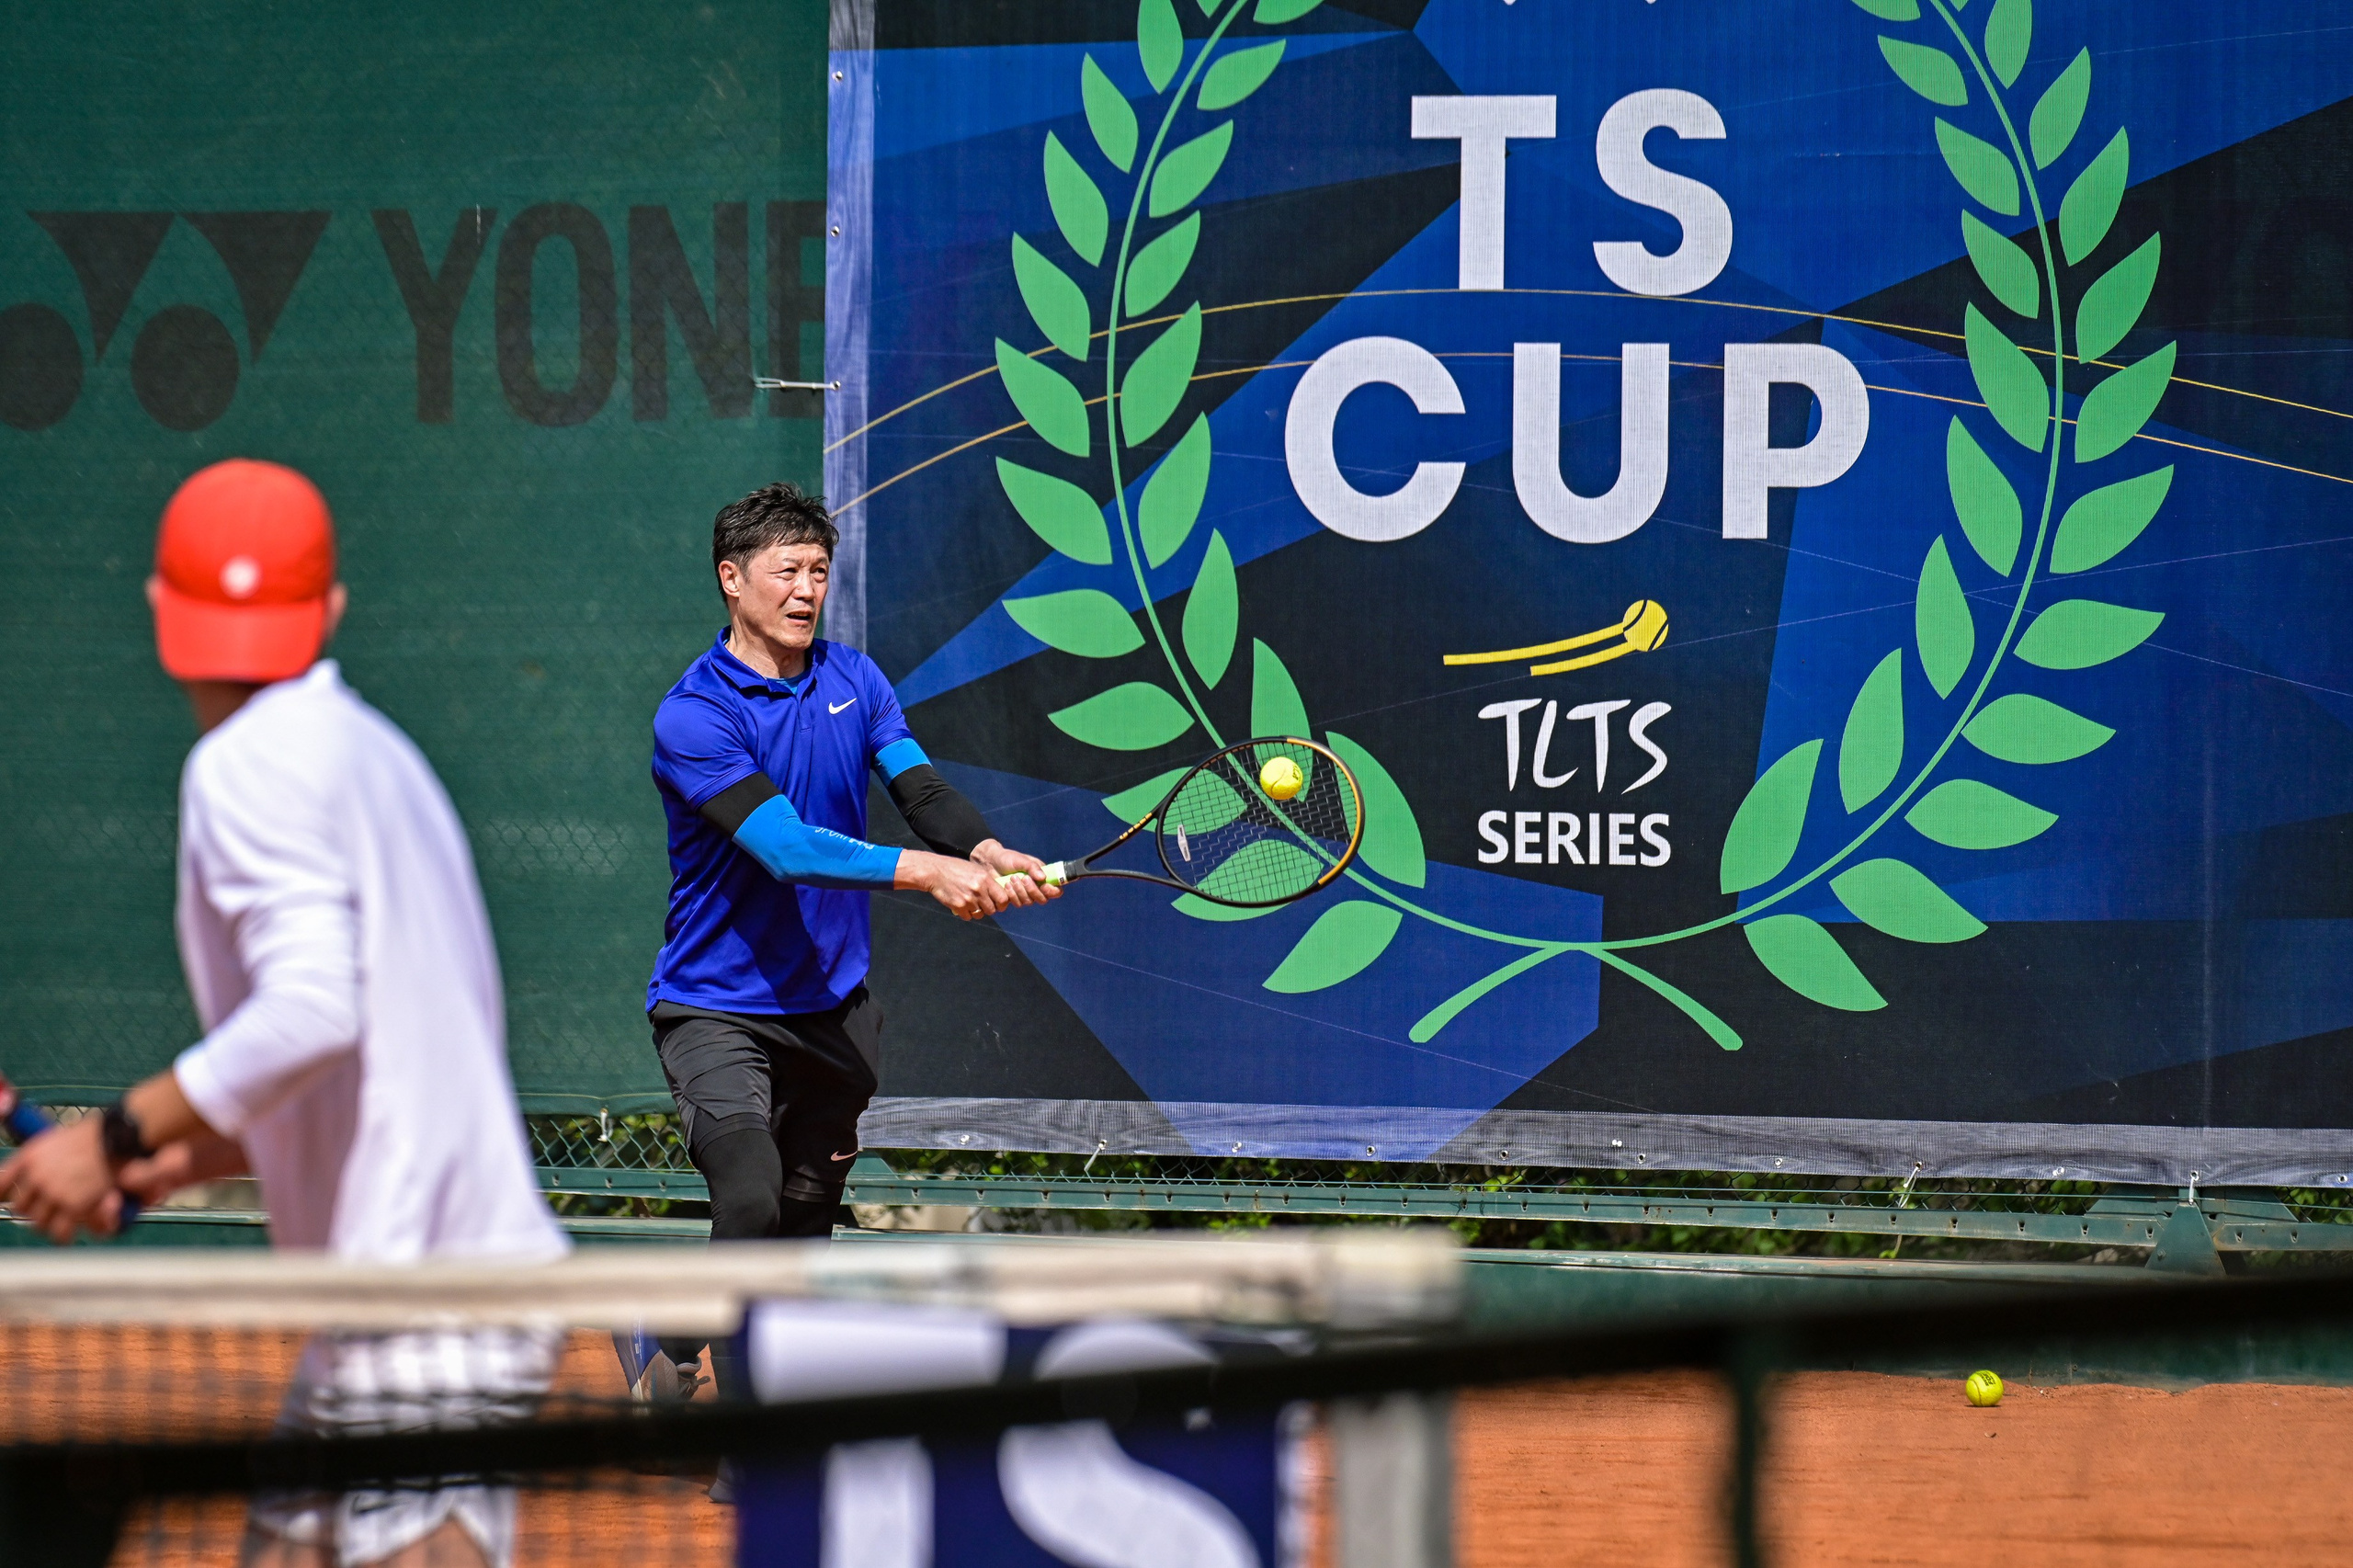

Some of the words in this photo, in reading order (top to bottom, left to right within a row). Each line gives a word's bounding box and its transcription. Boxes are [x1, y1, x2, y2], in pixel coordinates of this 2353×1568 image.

[1411, 88, 1733, 296] TS
[1285, 336, 1870, 543] CUP
[1477, 698, 1672, 795] TLTS
[1477, 810, 1672, 867] SERIES
